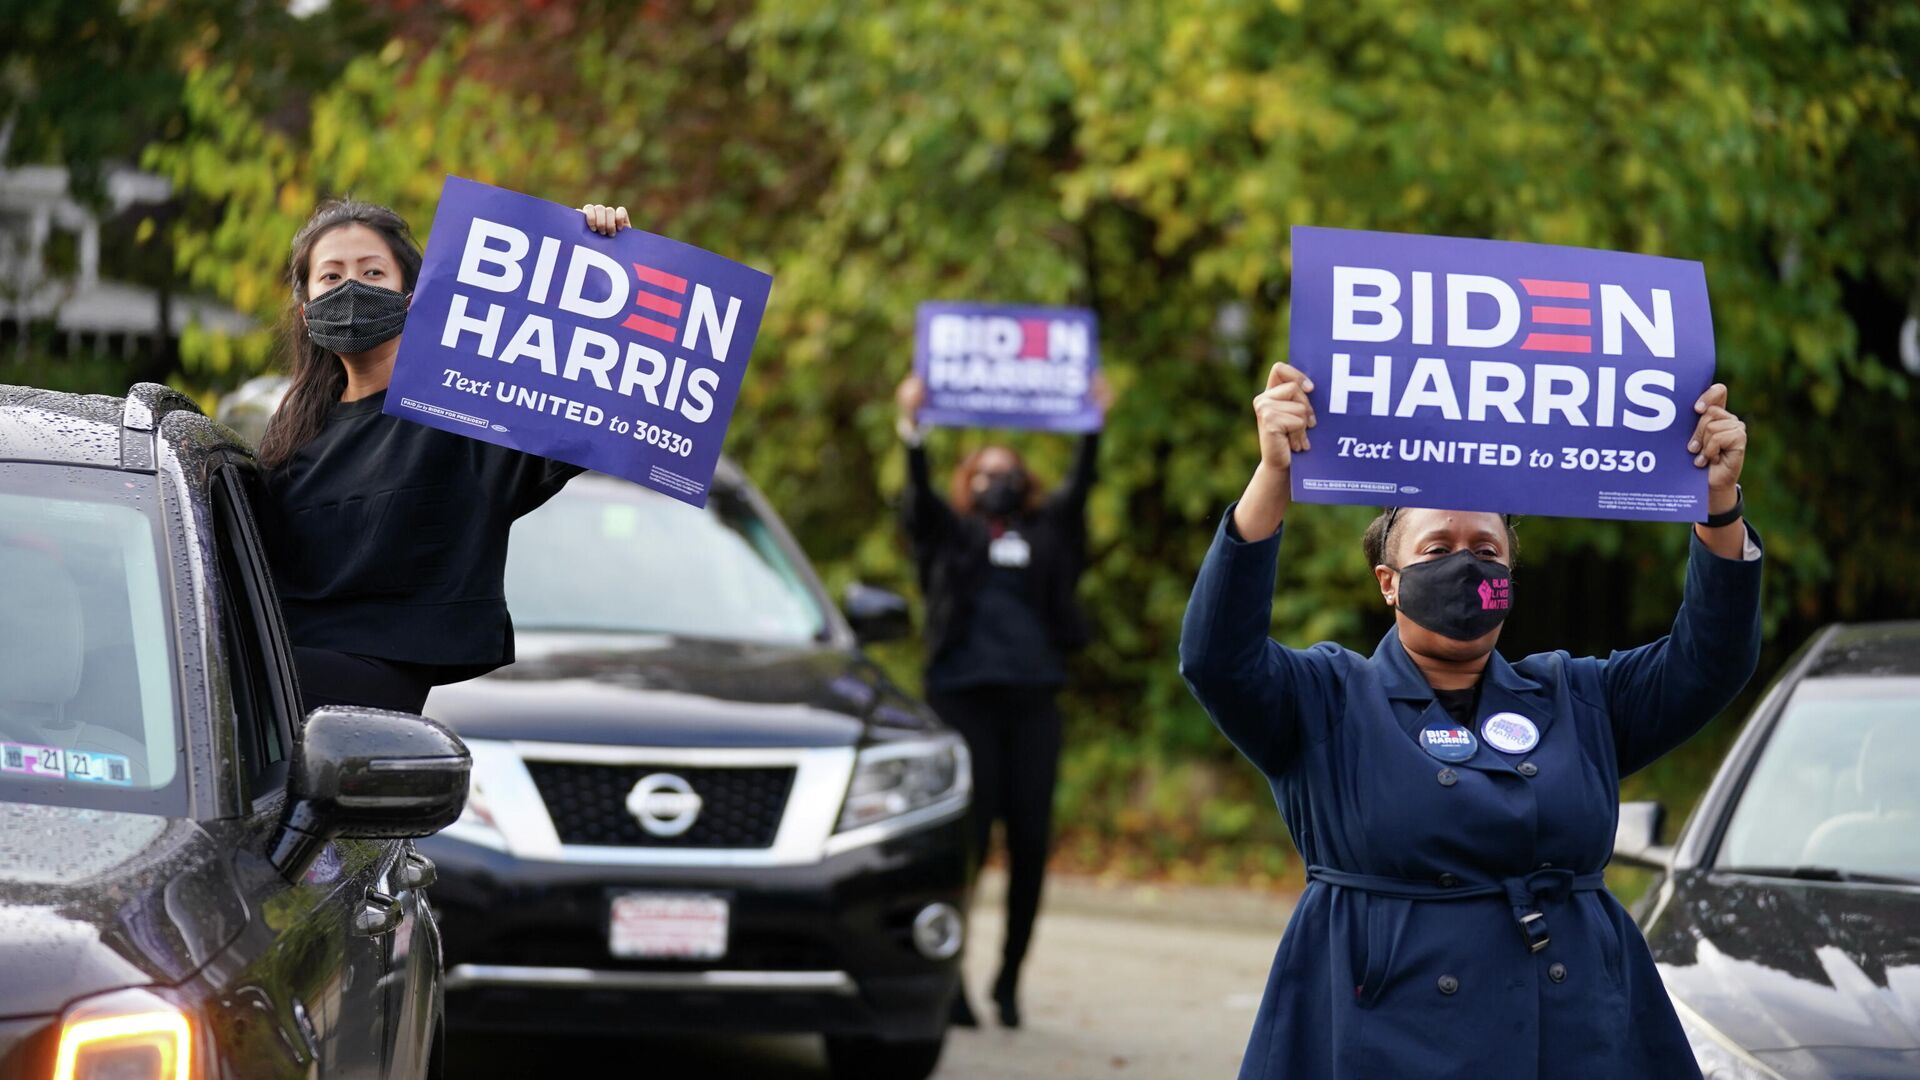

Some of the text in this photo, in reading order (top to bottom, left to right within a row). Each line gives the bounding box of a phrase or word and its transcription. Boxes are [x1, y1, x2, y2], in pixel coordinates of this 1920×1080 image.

[456, 217, 742, 362] BIDEN
[1332, 265, 1676, 359] BIDEN
[440, 293, 720, 424] HARRIS
[441, 368, 693, 458] Text UNITED to 30330
[1328, 353, 1677, 432] HARRIS
[1337, 437, 1656, 474] Text UNITED to 30330
[43, 749, 60, 770] 21
[1426, 730, 1468, 739] BIDEN
[1429, 737, 1470, 745] HARRIS
[73, 754, 91, 775] 21
